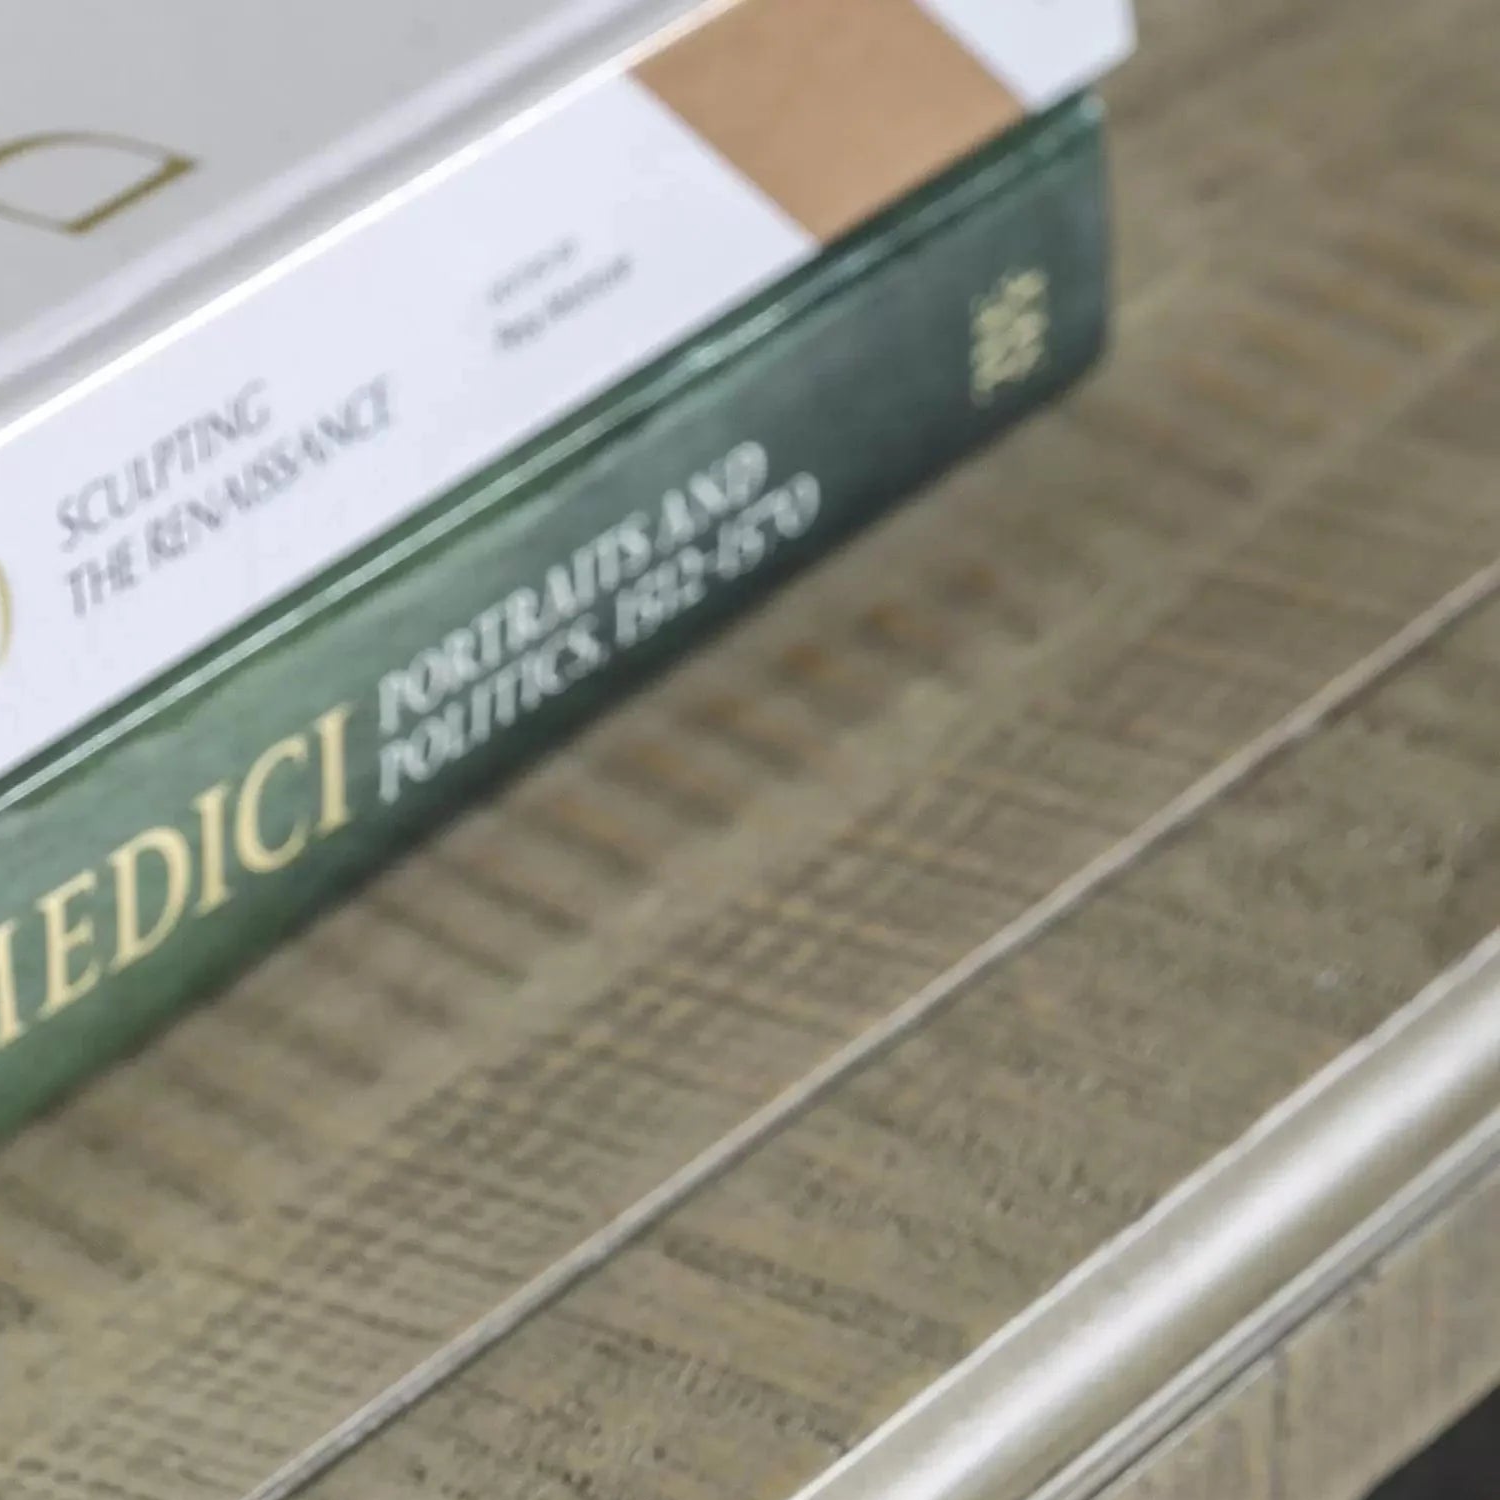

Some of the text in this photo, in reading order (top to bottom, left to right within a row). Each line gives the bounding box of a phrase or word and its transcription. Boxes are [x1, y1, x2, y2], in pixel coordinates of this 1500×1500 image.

[56, 377, 272, 552] SCULPTING
[66, 374, 392, 617] THE RENAISSANCE
[378, 441, 768, 737] PORTRAITS AND
